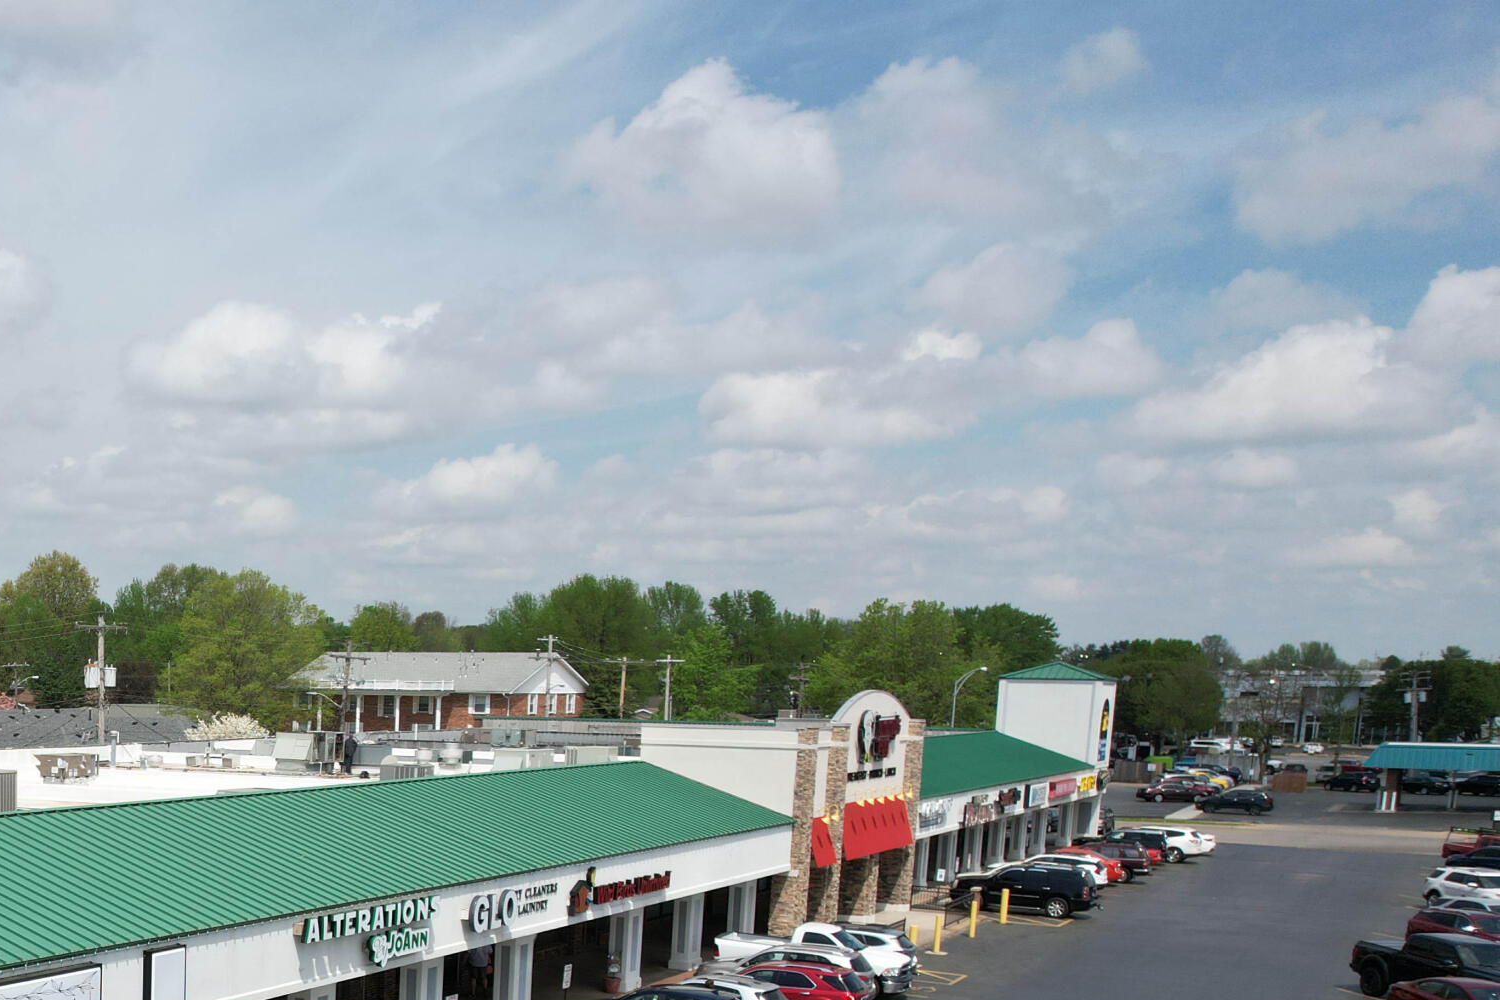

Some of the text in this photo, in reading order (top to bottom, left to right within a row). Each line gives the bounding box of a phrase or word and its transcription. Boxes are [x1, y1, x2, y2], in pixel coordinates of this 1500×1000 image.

[525, 883, 558, 899] CLEANERS
[304, 896, 440, 944] ALTERATIONS
[469, 888, 517, 933] GLO
[518, 900, 548, 915] LAUNDRY
